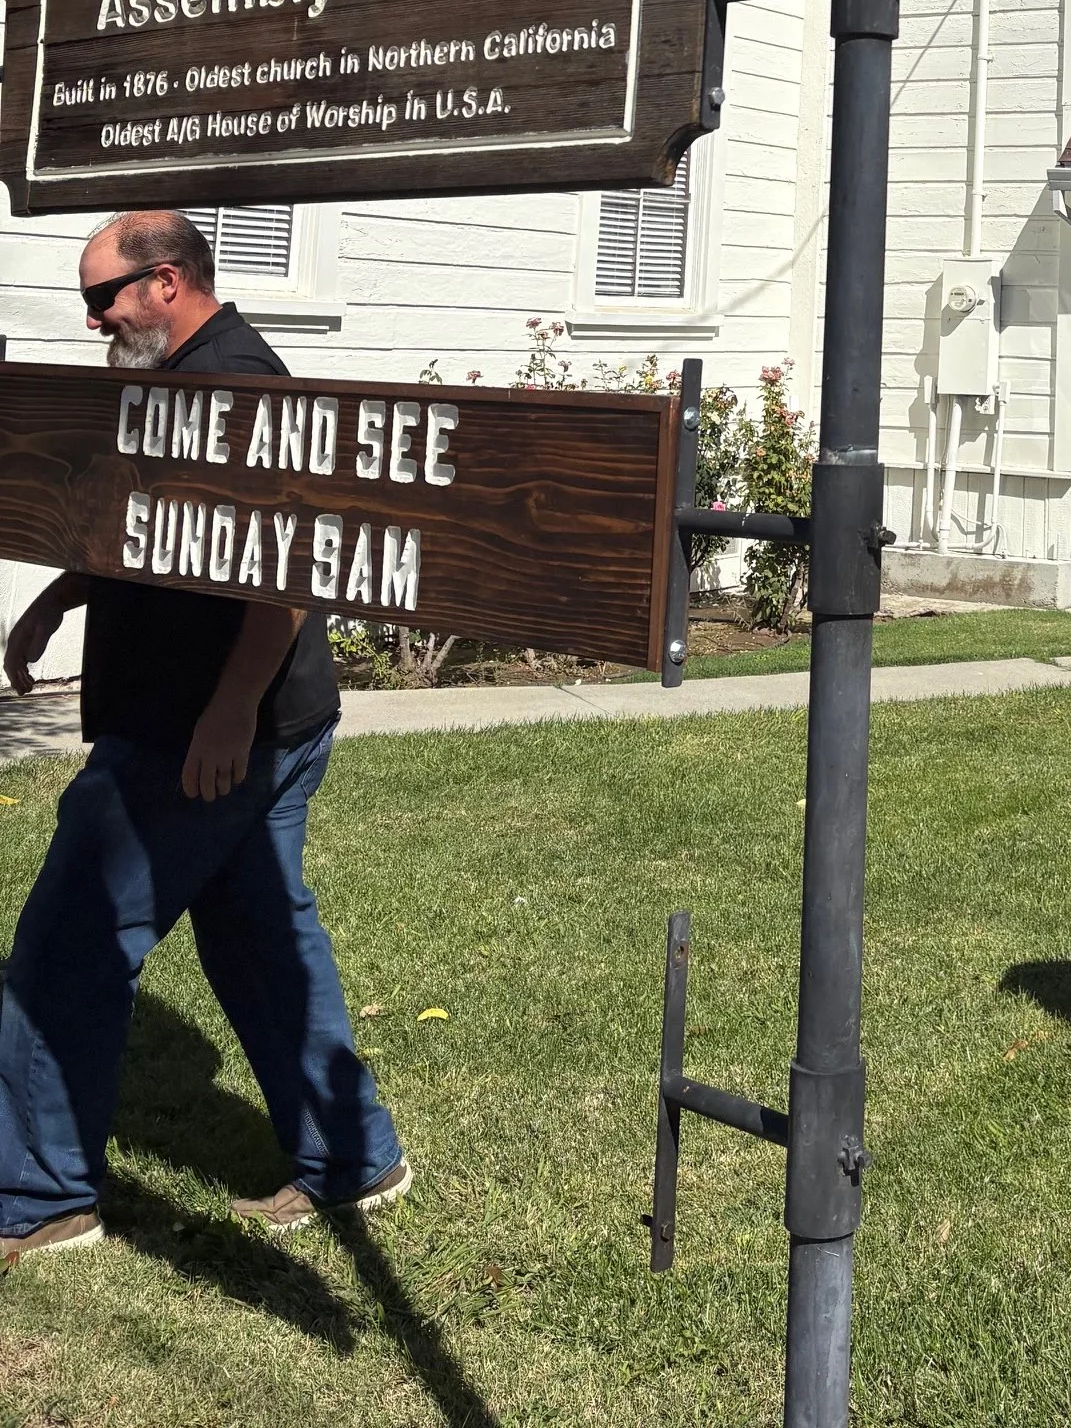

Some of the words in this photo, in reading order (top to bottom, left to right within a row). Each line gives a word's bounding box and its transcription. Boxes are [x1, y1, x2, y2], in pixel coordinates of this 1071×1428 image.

[52, 78, 95, 107] Built
[99, 77, 117, 101] in
[186, 61, 251, 92] Oldest
[256, 52, 332, 85] church
[339, 47, 360, 74] in
[368, 38, 476, 72] Northern
[483, 18, 616, 61] California
[101, 119, 161, 148] Oldest
[166, 115, 200, 144] A/G
[207, 110, 272, 138] House
[276, 103, 301, 133] of
[306, 93, 397, 131] Worship
[405, 89, 427, 120] in
[436, 85, 512, 119] U.S.A.
[117, 385, 234, 464] COME
[247, 393, 340, 476] AND
[355, 399, 460, 487] SEE
[123, 491, 297, 591] SUNDAY
[311, 513, 422, 612] 9AM
